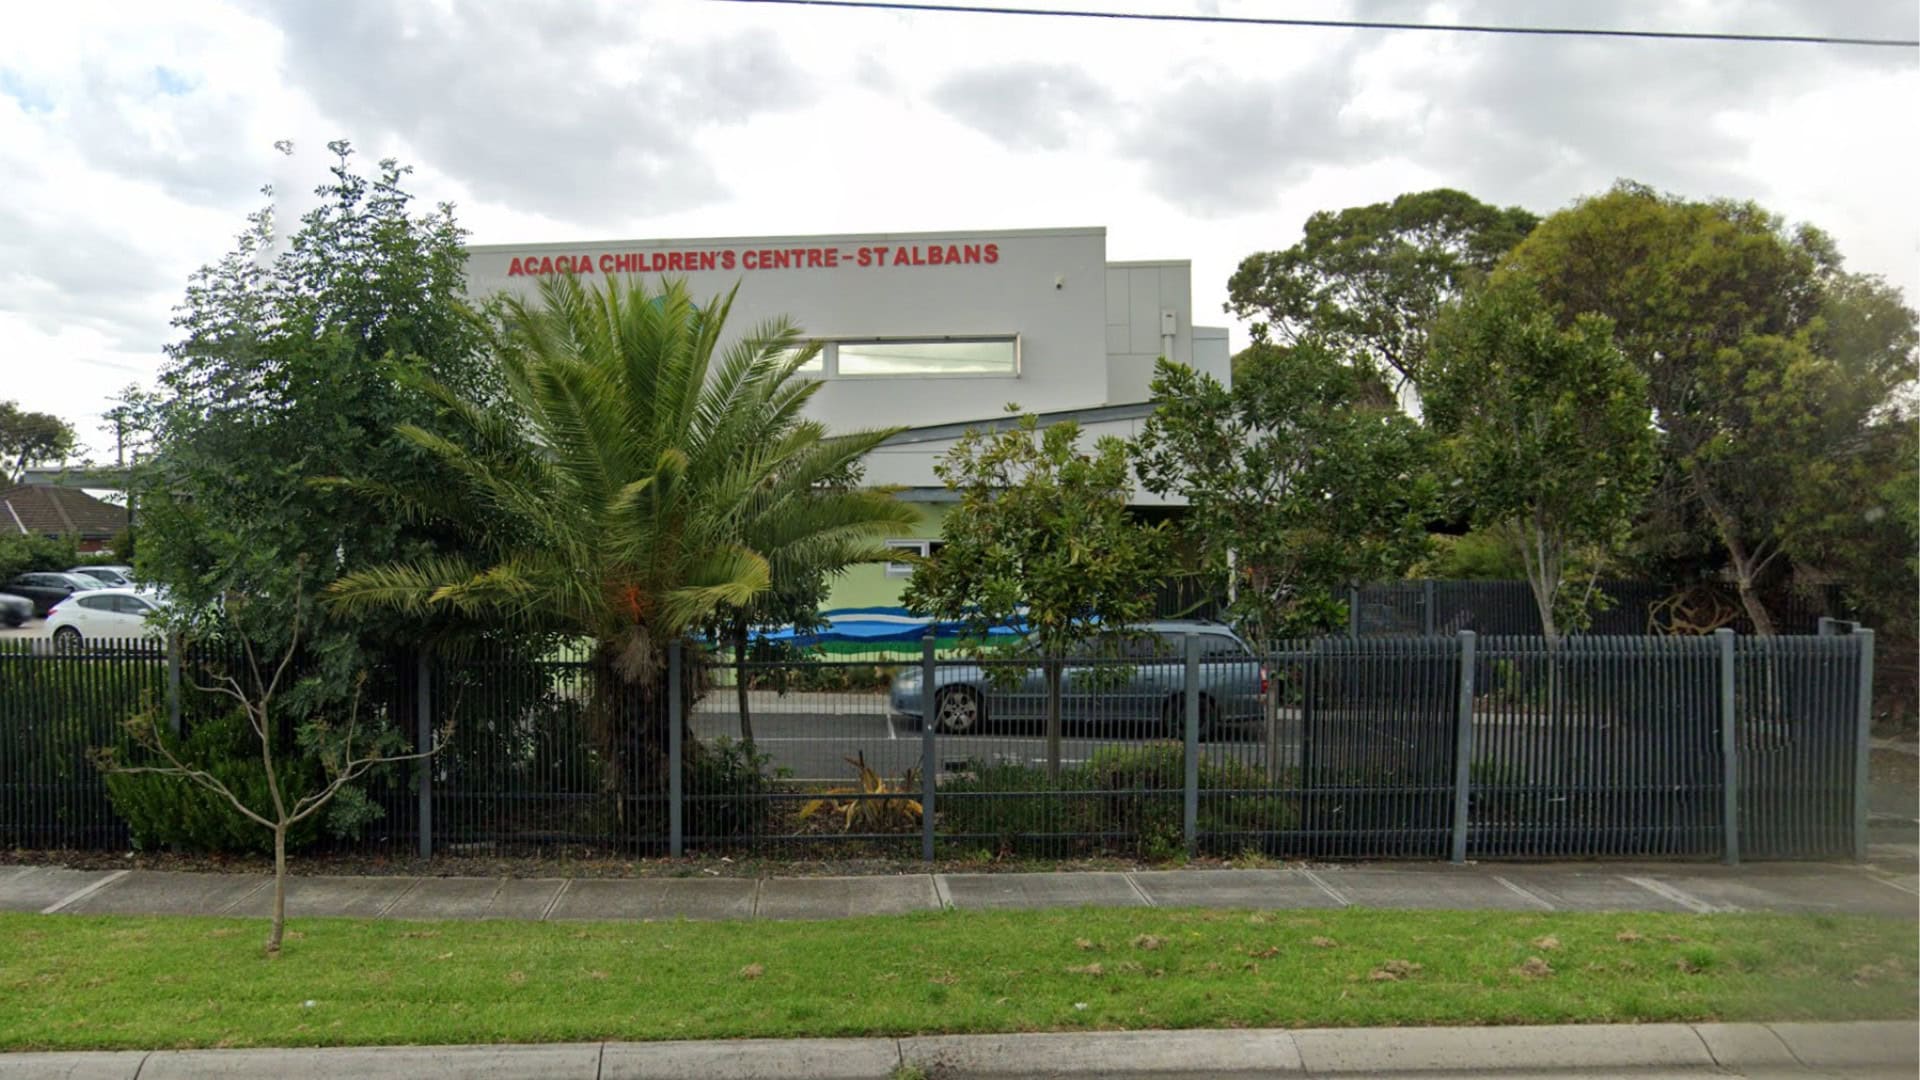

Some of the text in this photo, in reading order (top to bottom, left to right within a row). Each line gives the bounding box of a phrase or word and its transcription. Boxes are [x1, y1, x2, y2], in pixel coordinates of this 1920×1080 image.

[508, 255, 594, 276] ACACIA
[598, 250, 736, 273] CHILDREN'S
[742, 248, 838, 270] CENTRE
[857, 246, 889, 267] ST
[893, 243, 999, 266] ALBANS
